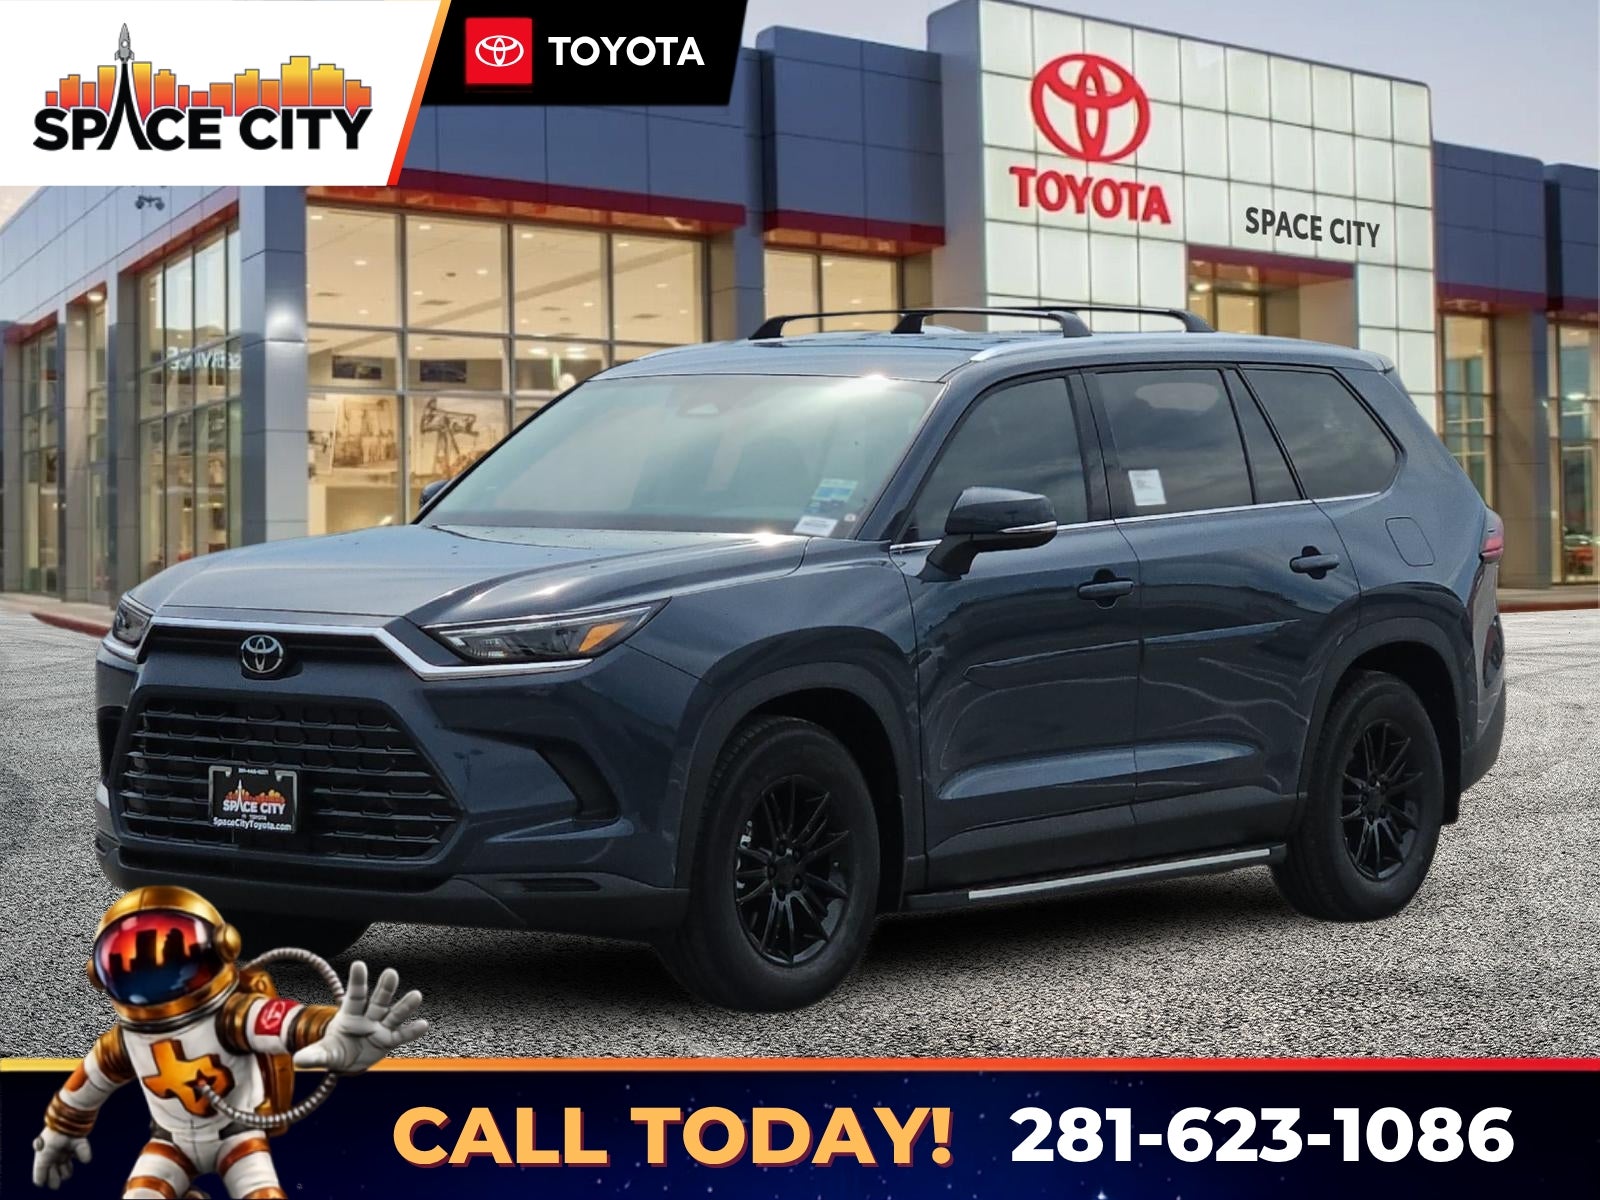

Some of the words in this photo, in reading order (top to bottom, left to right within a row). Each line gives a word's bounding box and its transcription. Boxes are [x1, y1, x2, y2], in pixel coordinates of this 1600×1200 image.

[1009, 166, 1171, 224] TOYOTA
[1245, 206, 1322, 242] SPACE
[1330, 217, 1380, 248] CITY
[222, 797, 258, 813] SPACE
[260, 802, 287, 815] CITY
[213, 816, 292, 831] SpaceCityToyota.com
